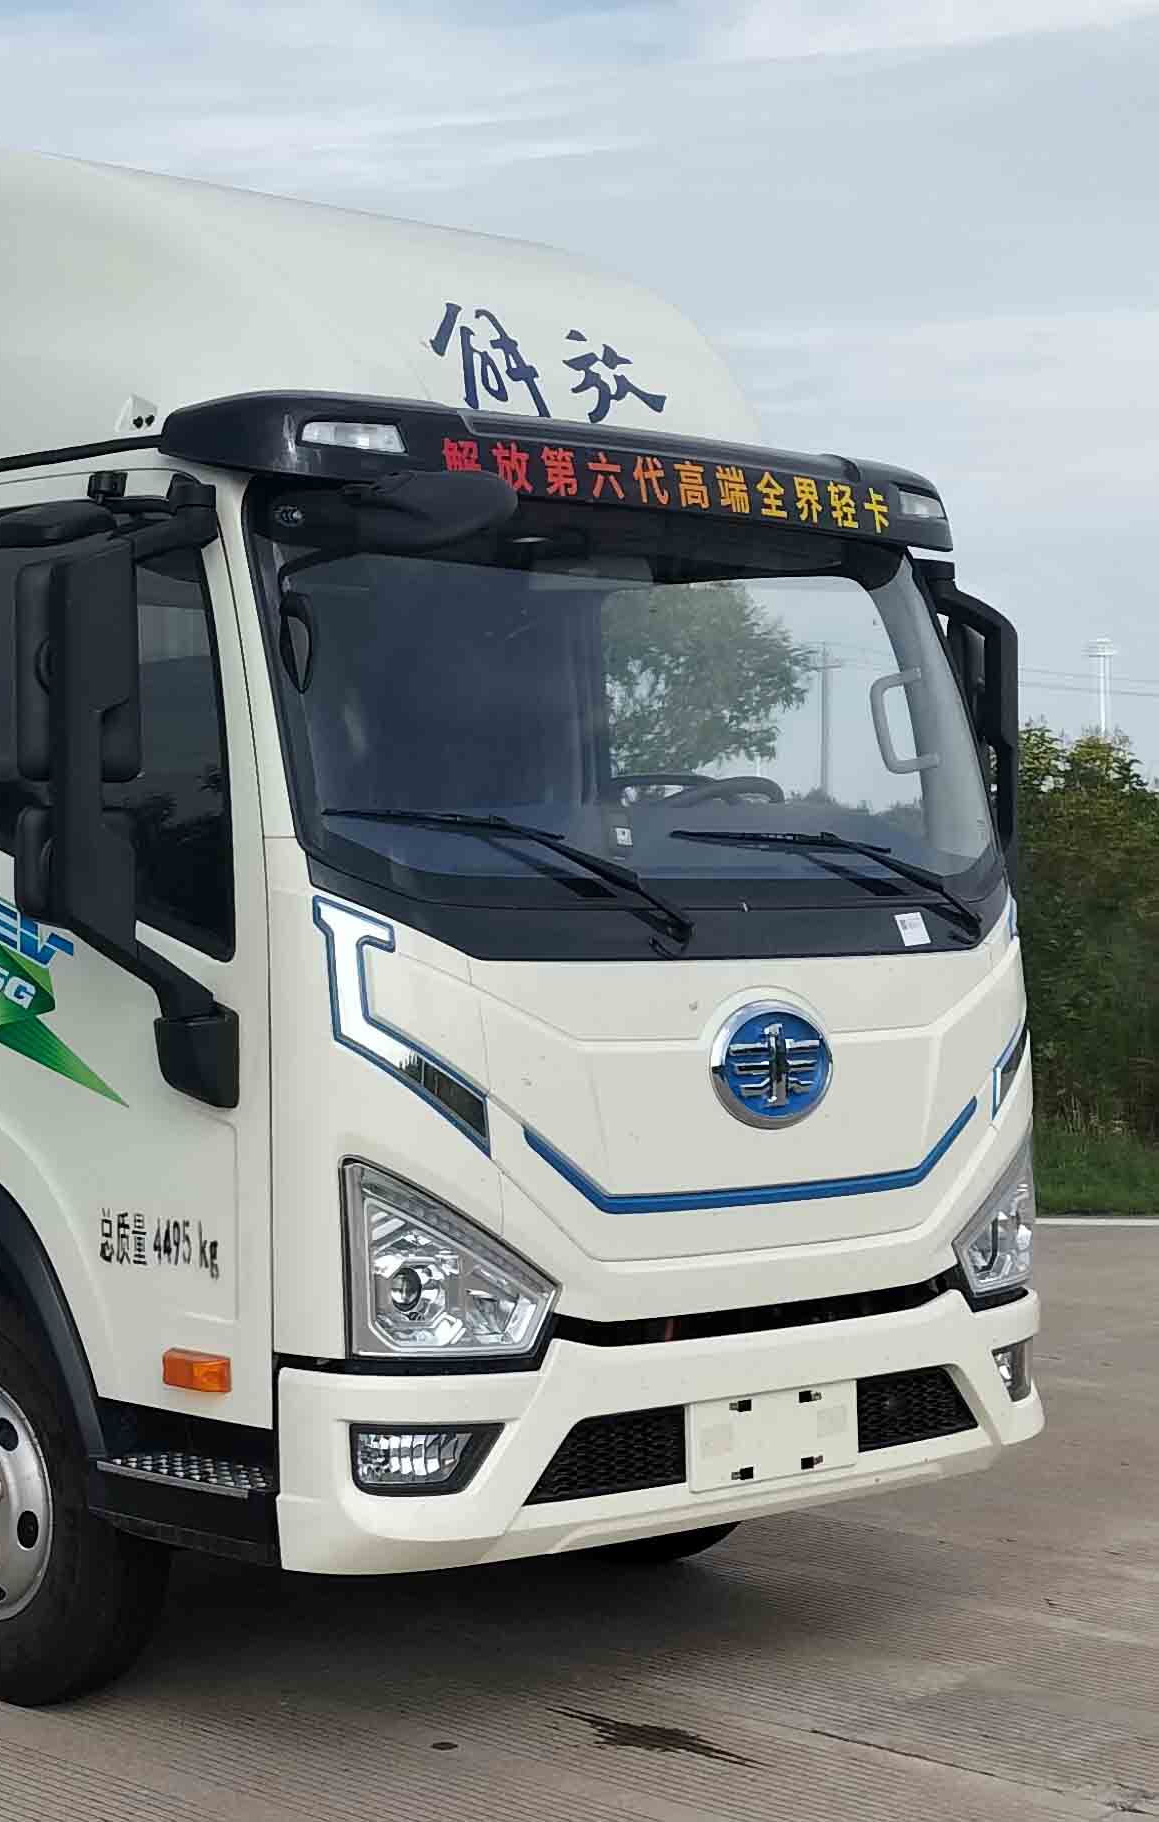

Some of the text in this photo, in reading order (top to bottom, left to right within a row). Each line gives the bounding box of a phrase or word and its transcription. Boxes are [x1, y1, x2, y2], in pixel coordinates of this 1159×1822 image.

[99, 1207, 220, 1281] 总质量 4495 kg
